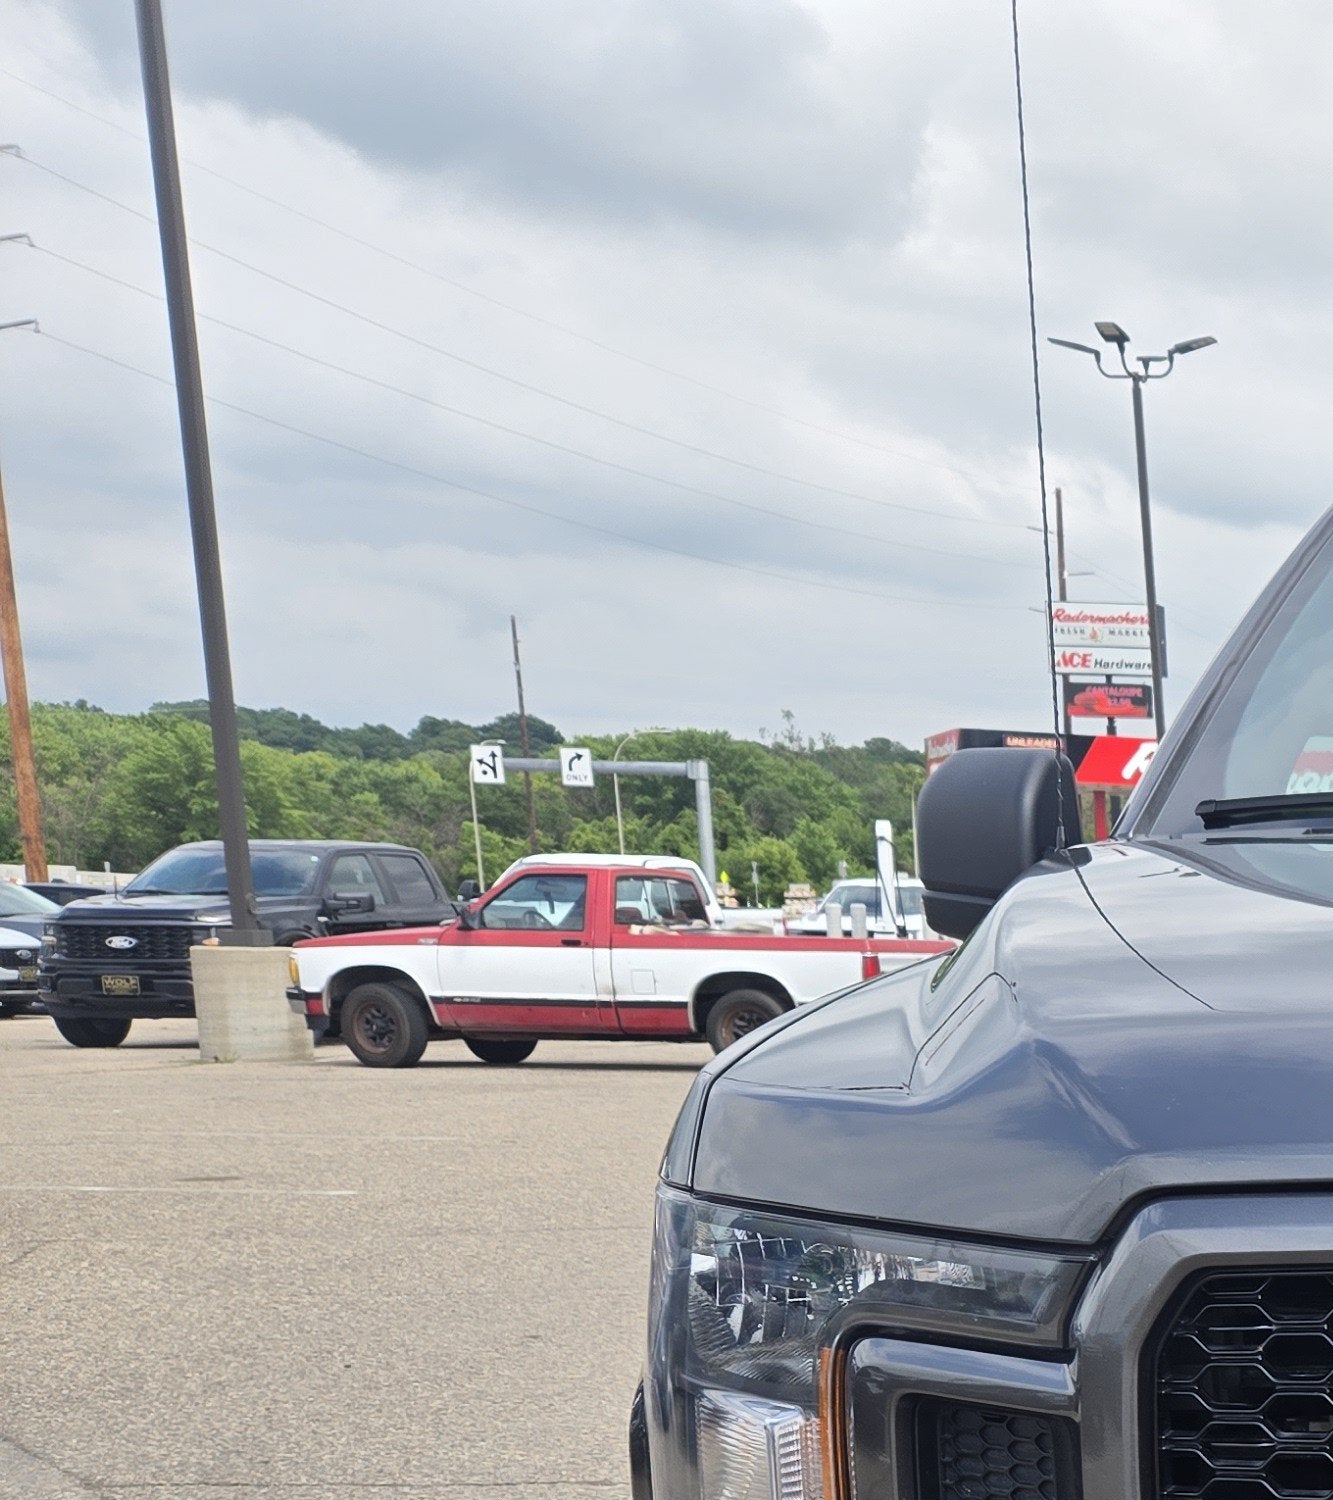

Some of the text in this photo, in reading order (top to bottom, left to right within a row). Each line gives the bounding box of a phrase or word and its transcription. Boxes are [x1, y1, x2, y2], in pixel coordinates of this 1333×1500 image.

[1109, 628, 1150, 637] MARKE
[1056, 651, 1092, 668] ACE
[566, 774, 588, 782] ONLY
